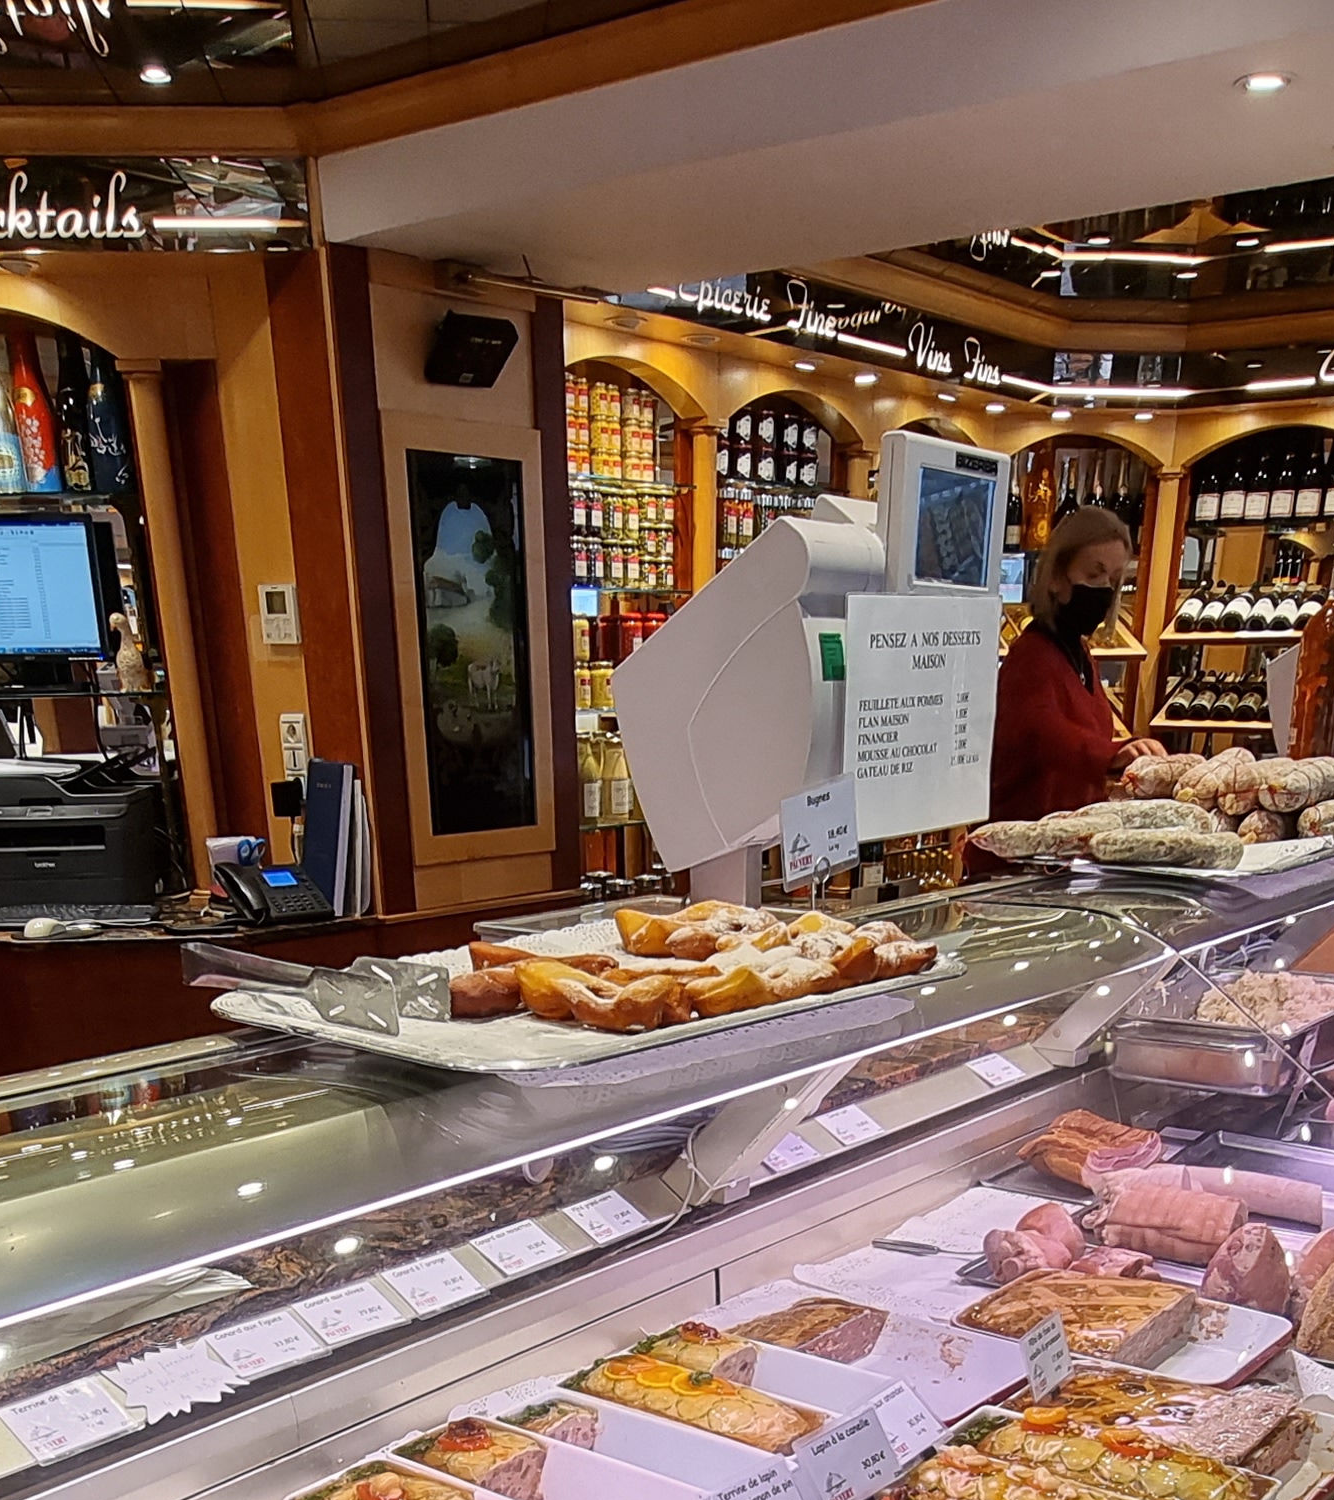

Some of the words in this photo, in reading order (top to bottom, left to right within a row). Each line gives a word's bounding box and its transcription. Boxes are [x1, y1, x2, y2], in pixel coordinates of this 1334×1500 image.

[786, 279, 838, 338] Fine
[908, 321, 953, 374] Vins
[964, 336, 1001, 386] Fins
[870, 632, 907, 649] PENSEZ
[910, 632, 918, 647] A
[921, 631, 939, 647] NOS
[942, 630, 981, 647] DESSERTS
[912, 653, 947, 670] MAISON
[858, 697, 898, 712] FEUILLETE
[898, 696, 916, 710] AUX
[917, 694, 944, 708] POMMES
[858, 715, 880, 729] FLAN
[880, 713, 910, 728] MAISON
[857, 731, 899, 747] FINANCIER
[857, 747, 889, 763] MOUSSE
[890, 746, 902, 760] AU
[902, 742, 938, 759] CHOCOLAT
[857, 764, 889, 780] GATEAU
[890, 763, 901, 776] DE
[901, 761, 914, 774] RIZ
[807, 791, 831, 807] Bugnes
[304, 1296, 330, 1309] Canard
[214, 1327, 243, 1341] Canard
[243, 1323, 258, 1332] aux
[258, 1315, 283, 1328] figues
[10, 1399, 47, 1416] Terrine
[48, 1393, 60, 1404] de
[811, 1438, 832, 1456] Lapin
[836, 1430, 846, 1442] la
[748, 1478, 760, 1490] de
[759, 1468, 779, 1486] lapin
[771, 1484, 782, 1497] de
[781, 1478, 794, 1494] pin
